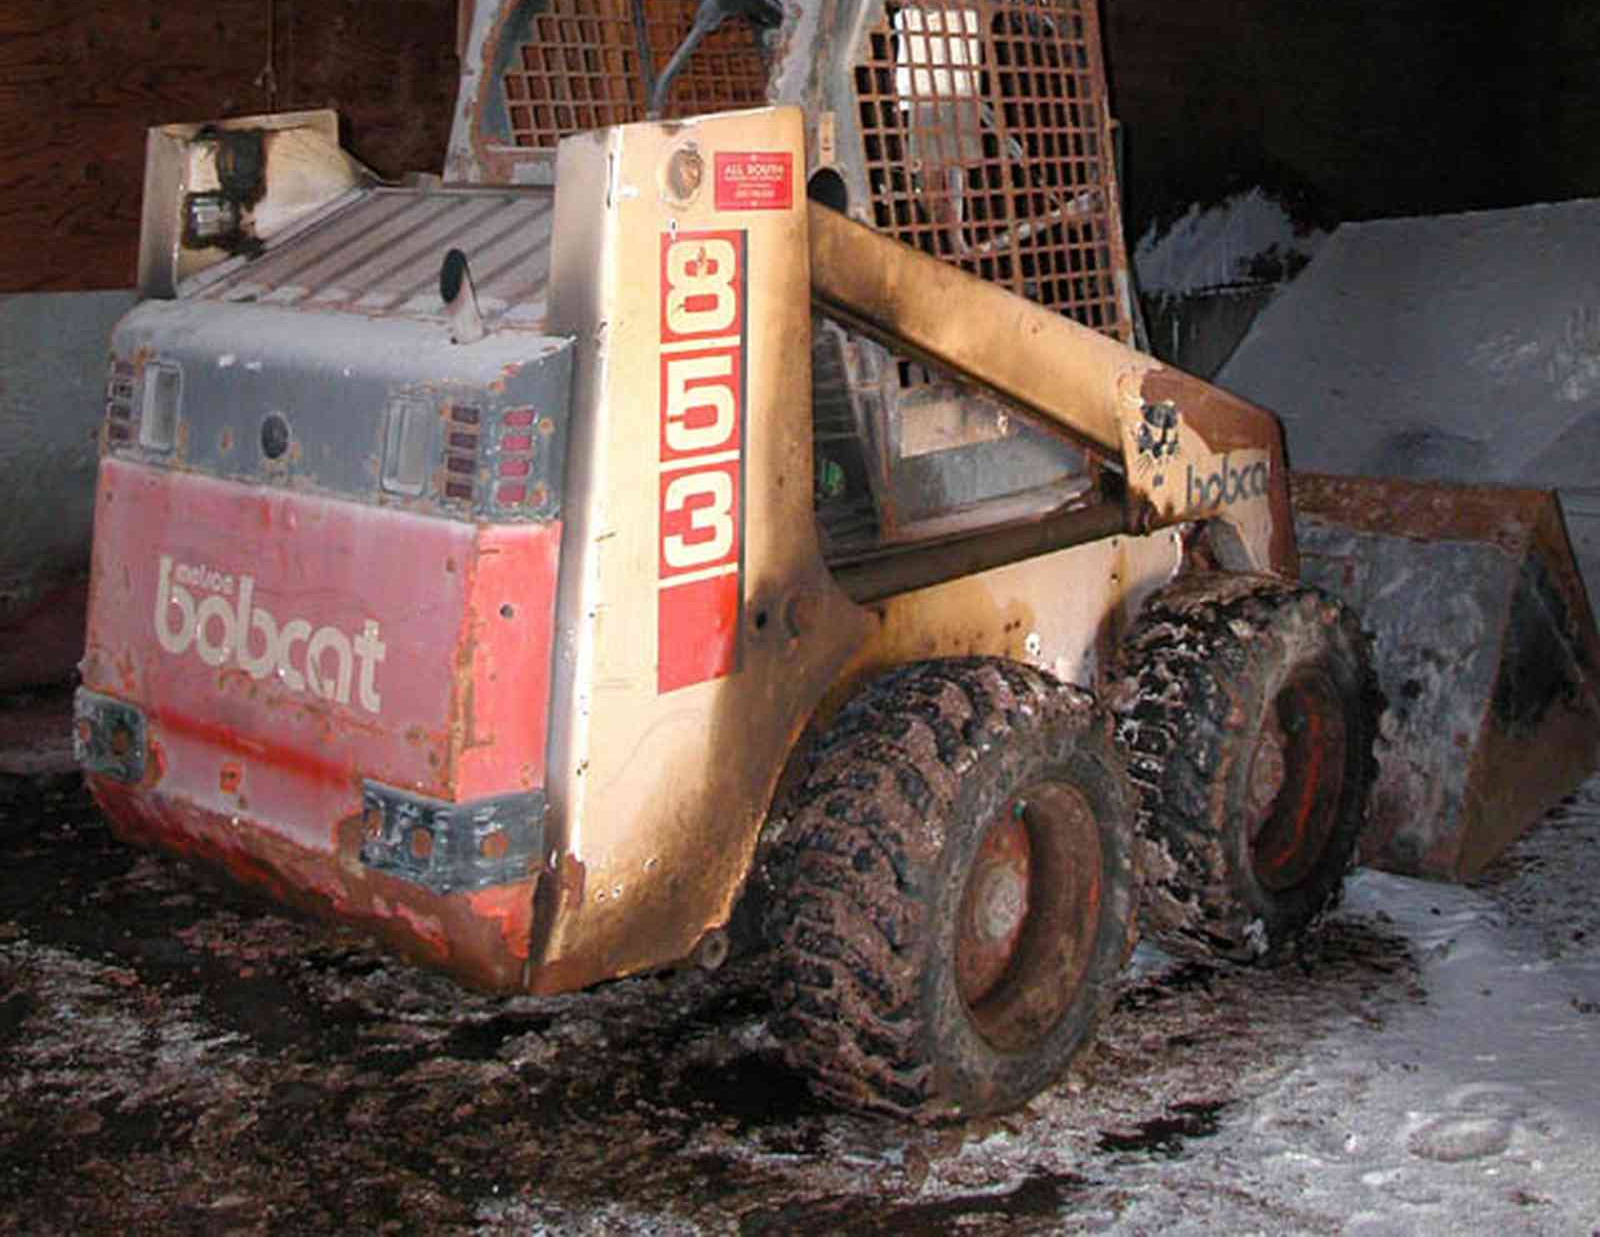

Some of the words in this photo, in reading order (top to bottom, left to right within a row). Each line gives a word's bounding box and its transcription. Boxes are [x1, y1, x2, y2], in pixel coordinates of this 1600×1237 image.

[724, 163, 744, 177] ALL
[746, 163, 785, 177] SOUTH
[664, 238, 736, 569] 853
[154, 555, 387, 713] bobcat
